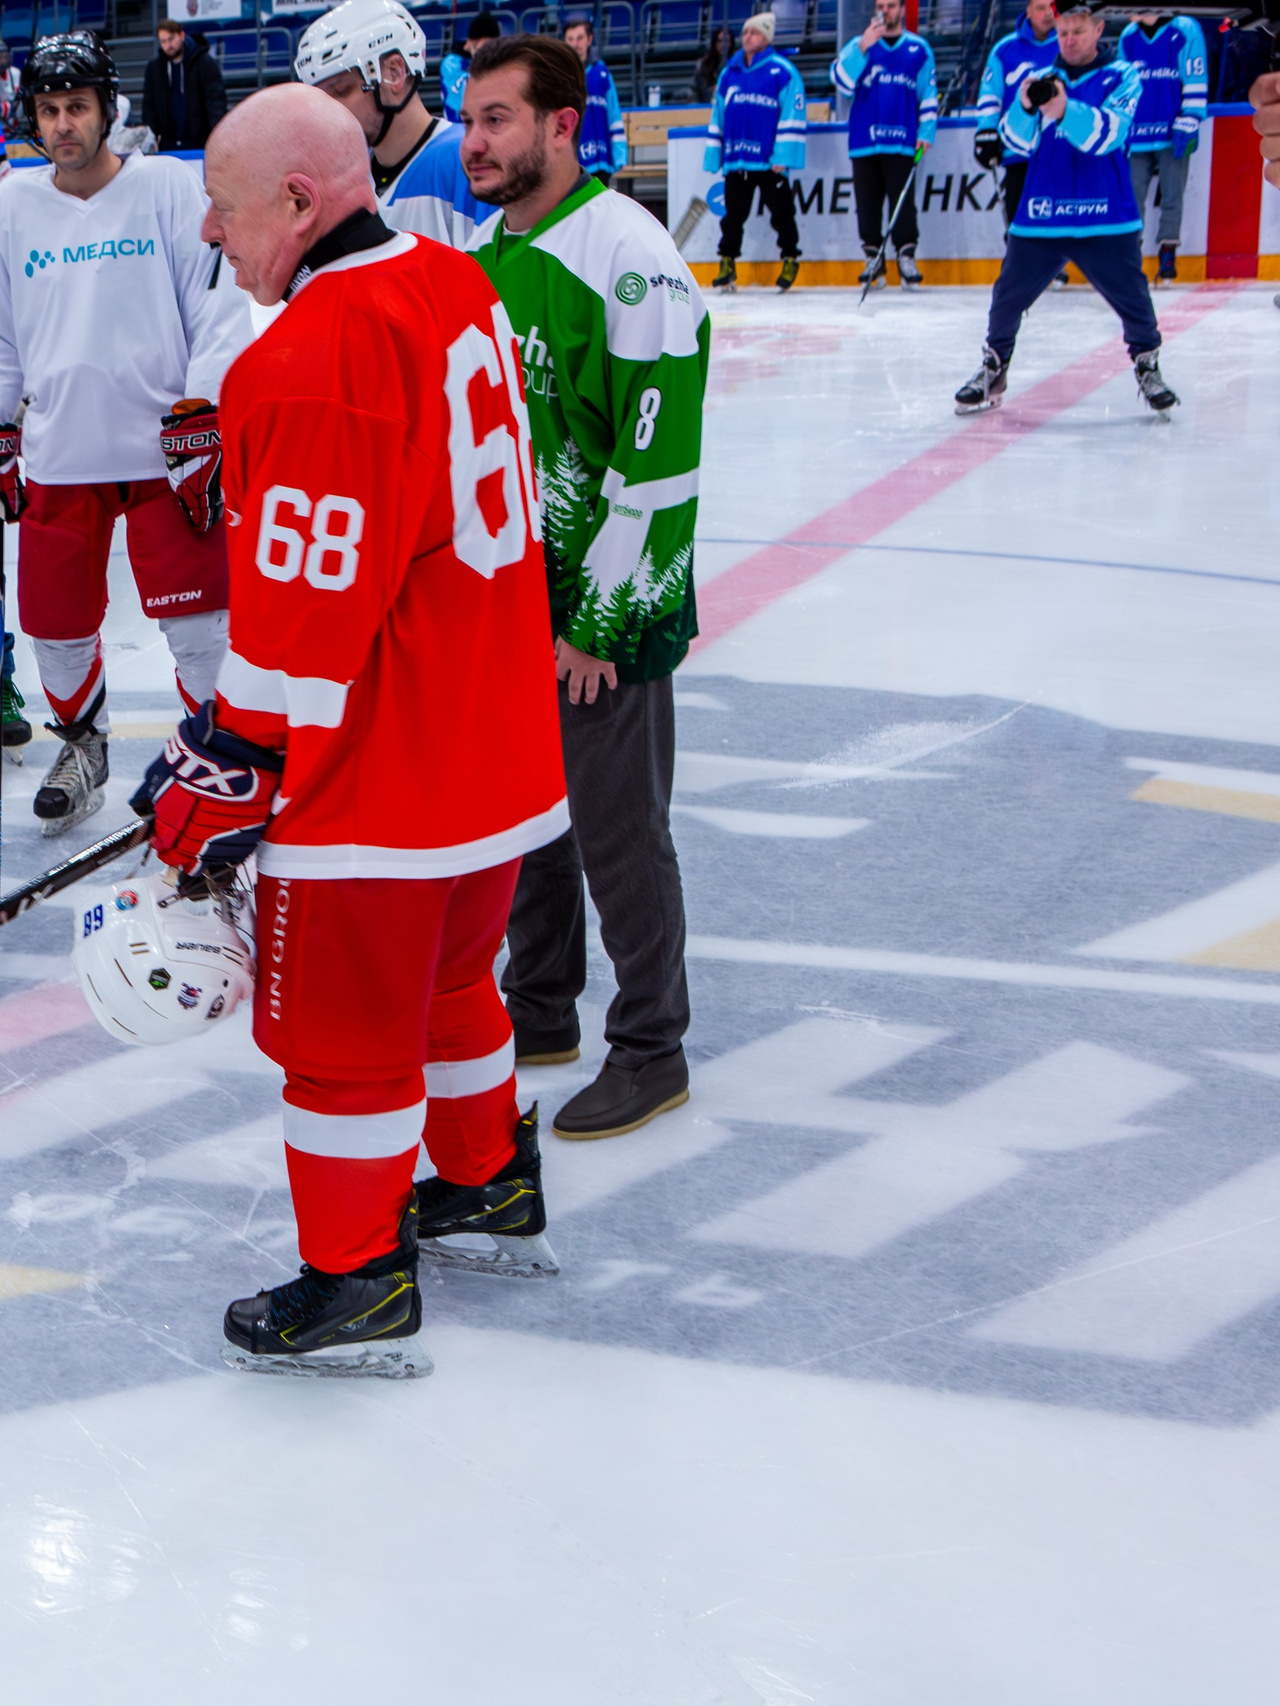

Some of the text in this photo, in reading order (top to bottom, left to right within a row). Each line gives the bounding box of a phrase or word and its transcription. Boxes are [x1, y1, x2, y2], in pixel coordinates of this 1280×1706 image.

[62, 239, 155, 264] МЕДСИ
[634, 386, 663, 452] 8
[161, 430, 223, 451] STON
[255, 484, 366, 592] 68
[146, 589, 203, 608] EASTON
